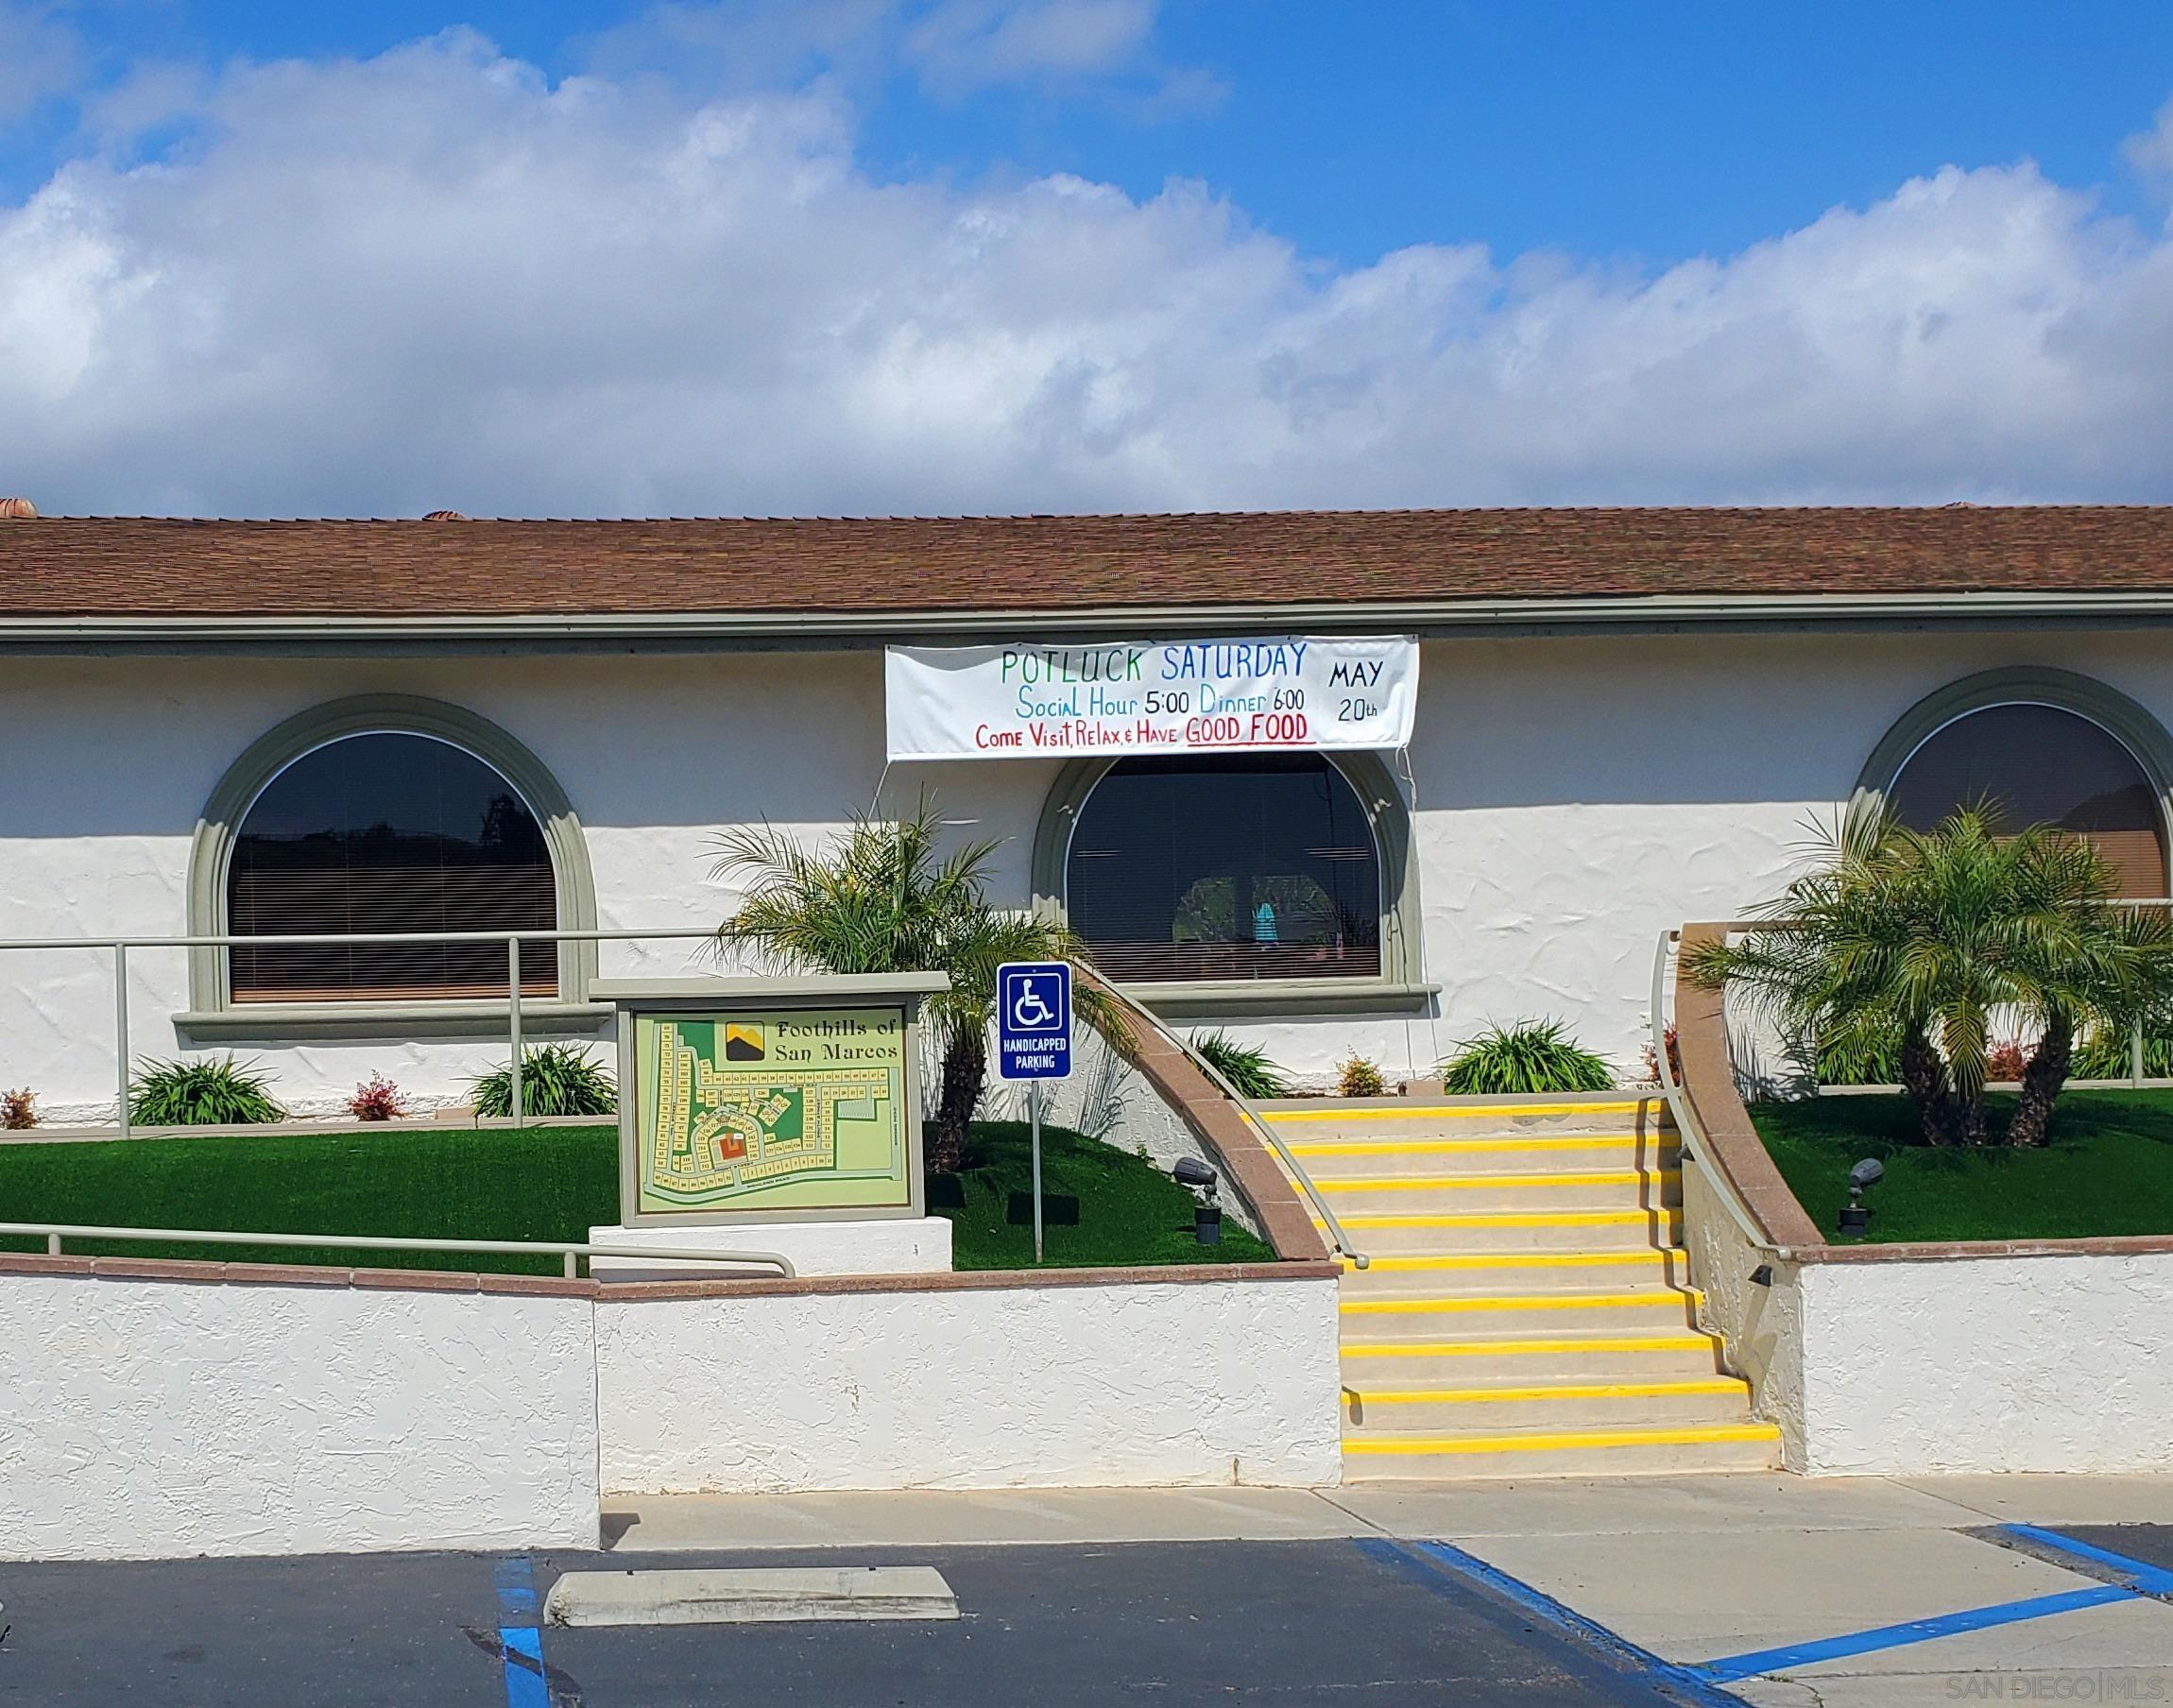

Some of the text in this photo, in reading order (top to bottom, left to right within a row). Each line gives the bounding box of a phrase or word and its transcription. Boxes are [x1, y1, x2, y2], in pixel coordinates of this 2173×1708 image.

[1001, 643, 1308, 684] POTLUCK SATURDAY
[1328, 660, 1383, 687] MAY
[1089, 686, 1138, 716] Hour
[1145, 691, 1189, 714] 5:00
[1274, 687, 1305, 710] 6:00
[1338, 698, 1377, 721] 20th
[1186, 716, 1240, 743] GOOD
[1251, 713, 1308, 741] FOOD
[776, 1018, 897, 1039] Foothills of
[776, 1043, 898, 1063] San Marcos
[1003, 1038, 1066, 1052] HANDICAPPED
[1016, 1055, 1054, 1069] PARKING
